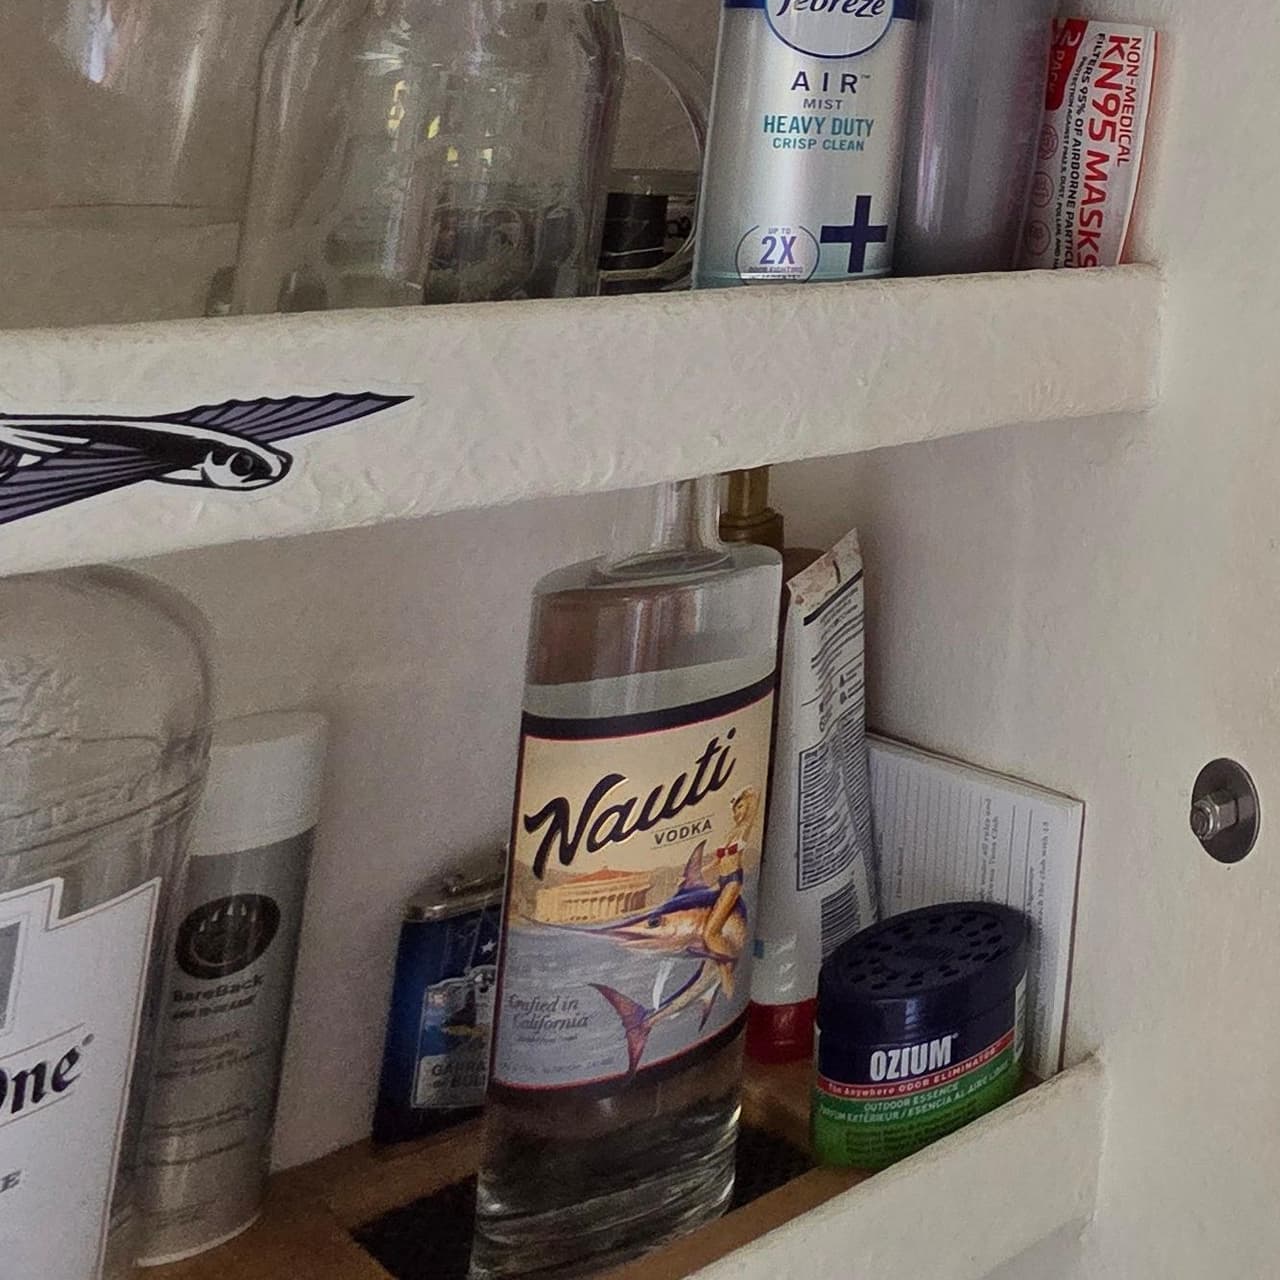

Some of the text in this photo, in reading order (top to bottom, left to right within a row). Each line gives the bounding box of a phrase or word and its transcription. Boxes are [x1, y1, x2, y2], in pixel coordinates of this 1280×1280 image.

[1081, 33, 1106, 84] FILTERS
[803, 98, 843, 110] MIST
[1075, 86, 1088, 116] 95%
[1117, 37, 1142, 167] NON-MEDICAL
[763, 115, 874, 137] HEAVY DUTY
[1074, 118, 1084, 137] OF
[772, 137, 864, 151] CRISP CLEAN
[1077, 35, 1130, 267] KN95 MASKS
[1066, 138, 1081, 209] AIRBORNE
[760, 236, 797, 265] 2X
[524, 727, 737, 880] Nauti
[654, 819, 712, 845] VODKA
[869, 1035, 952, 1082] OZIUM
[0, 1045, 82, 1114] ne
[898, 1079, 930, 1093] ODOR
[864, 1098, 911, 1112] OUTDOOR
